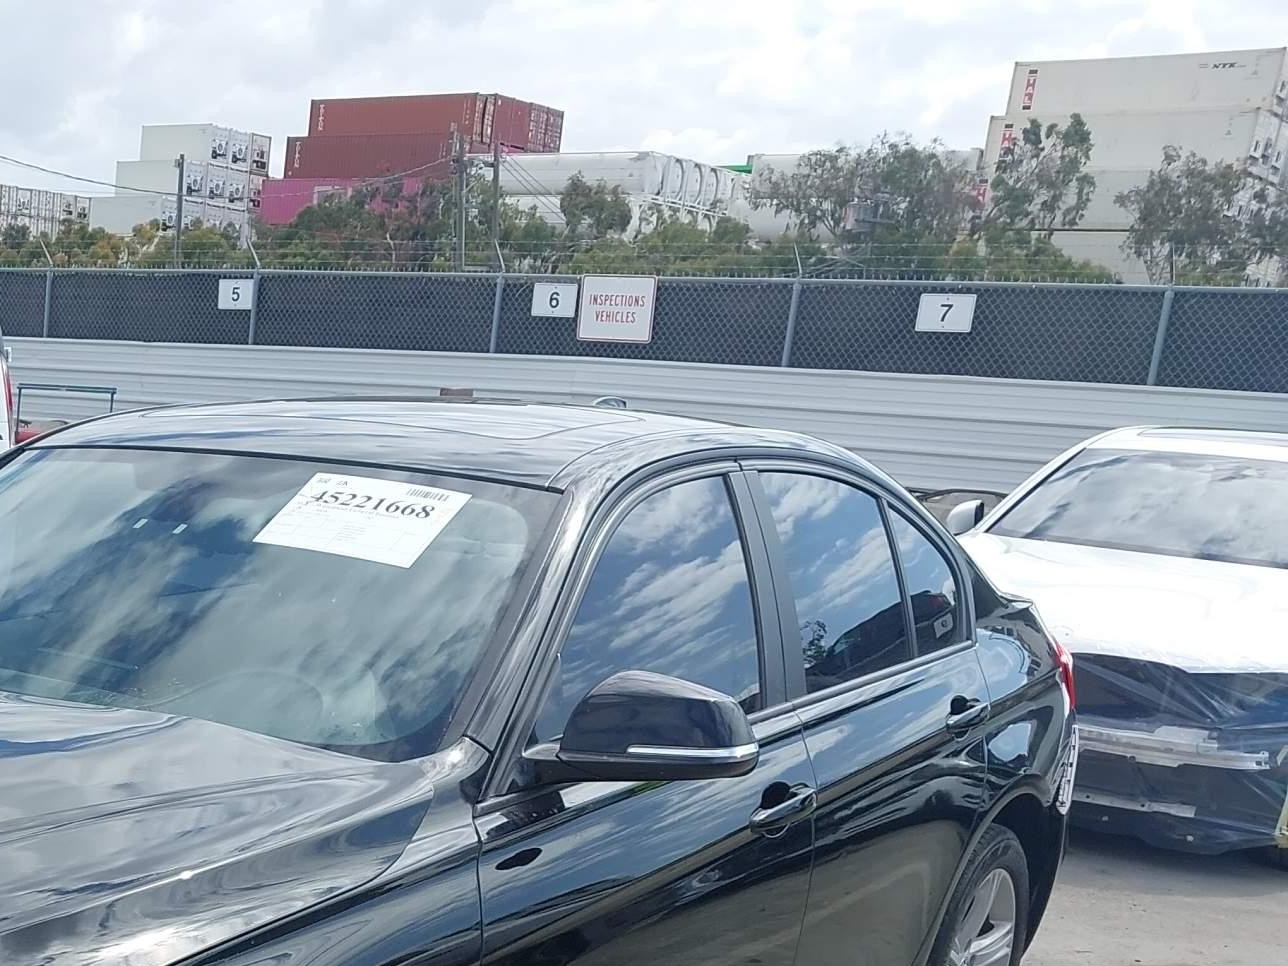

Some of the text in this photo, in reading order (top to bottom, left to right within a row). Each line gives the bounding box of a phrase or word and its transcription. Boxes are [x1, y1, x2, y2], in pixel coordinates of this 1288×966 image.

[231, 286, 241, 302] 5
[549, 291, 560, 309] 6
[589, 293, 646, 308] INSPECTIONS
[595, 310, 637, 324] VEHICLES
[940, 303, 954, 322] 7
[310, 490, 436, 519] 45221668
